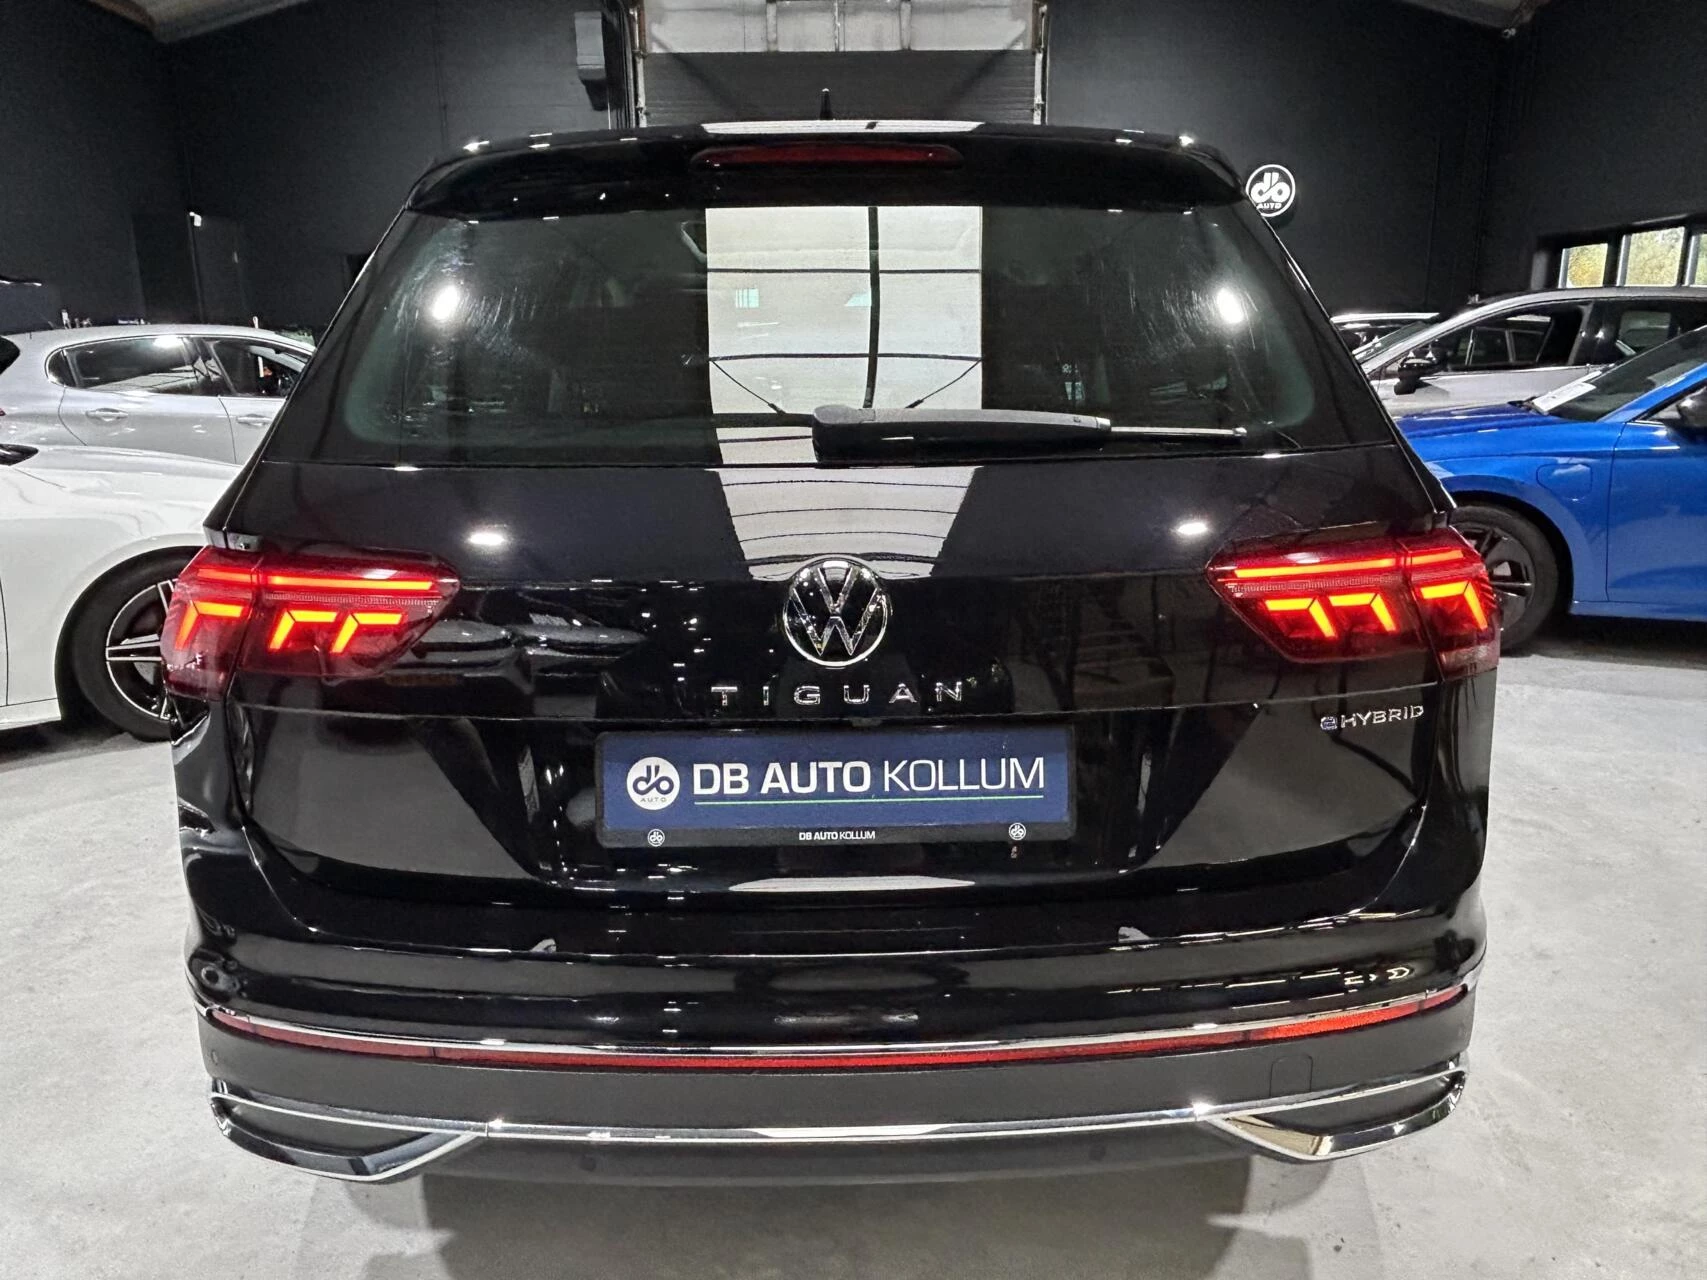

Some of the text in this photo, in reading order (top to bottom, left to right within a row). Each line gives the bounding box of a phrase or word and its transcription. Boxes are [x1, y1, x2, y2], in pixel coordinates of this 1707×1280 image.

[711, 681, 963, 707] TIGUAN
[693, 756, 1045, 795] DB AUTO KOLLUM
[799, 831, 875, 840] DB AUTO KOLLUM
